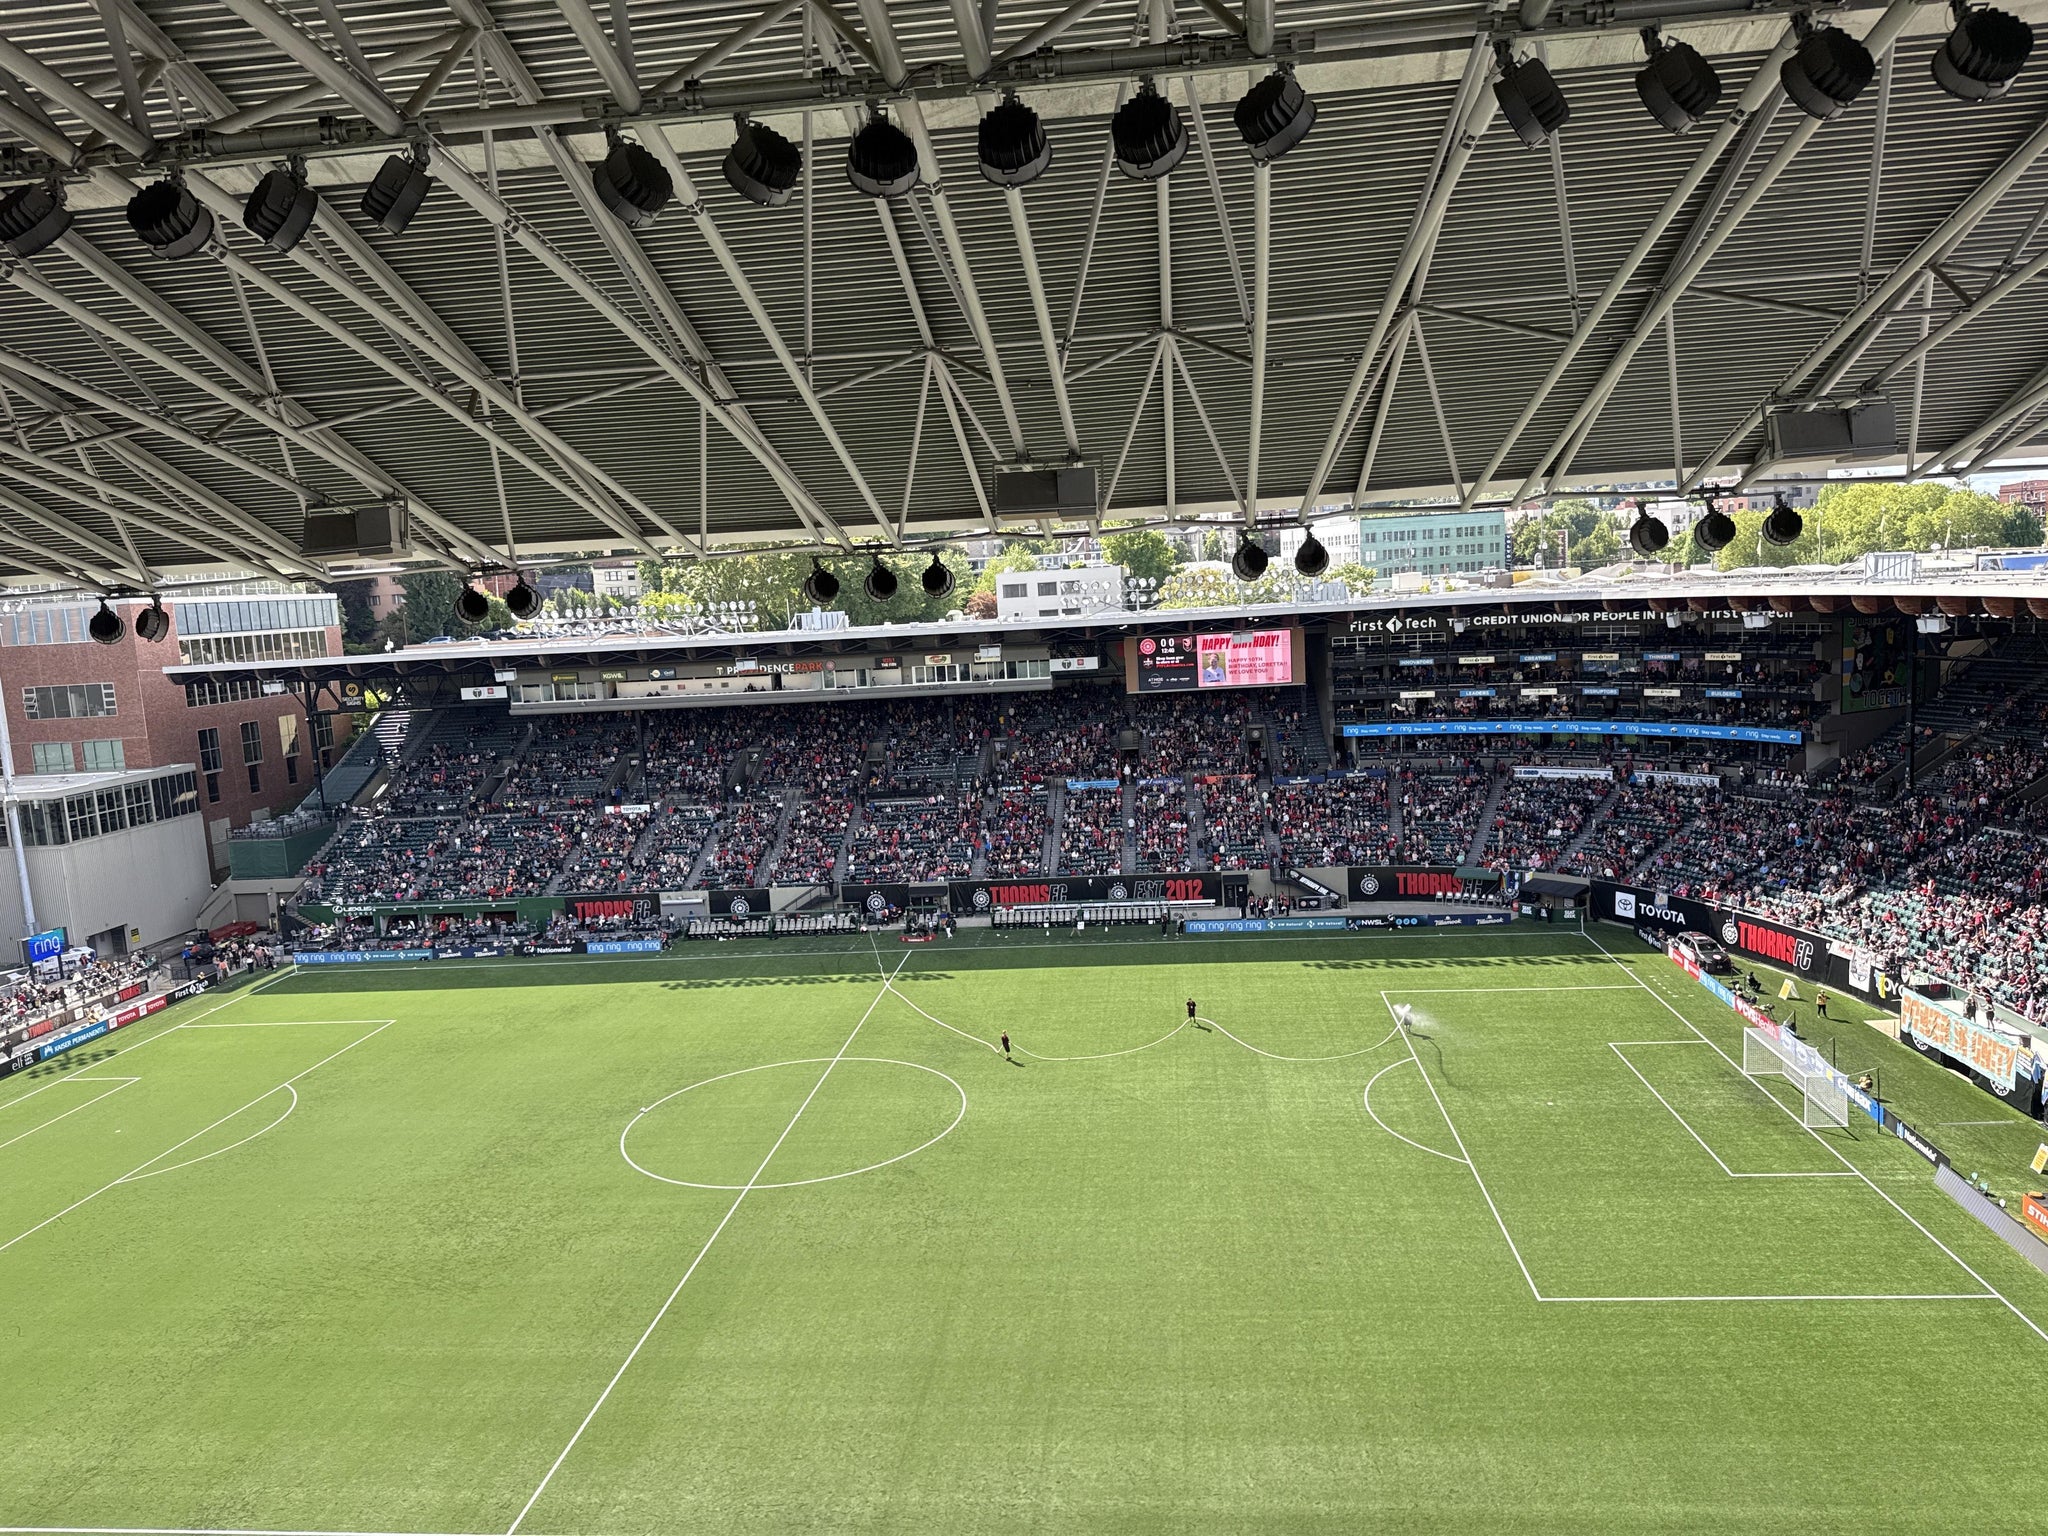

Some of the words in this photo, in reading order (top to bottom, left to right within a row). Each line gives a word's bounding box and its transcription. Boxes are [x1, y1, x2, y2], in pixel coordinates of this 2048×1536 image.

[1350, 620, 1383, 632] First
[1405, 617, 1437, 629] Tech
[1474, 615, 1518, 626] CREDIT
[1521, 613, 1562, 624] UNION
[1593, 611, 1639, 621] PEOPLE
[1643, 610, 1656, 620] IN
[1161, 639, 1165, 647] 0
[1169, 638, 1174, 647] 0
[1201, 637, 1231, 651] HAPPY
[1626, 725, 1639, 733] ring
[1686, 727, 1699, 735] ring
[1746, 731, 1758, 739] ring
[1134, 880, 1166, 899] EST
[1165, 879, 1203, 900] 2012
[1396, 872, 1462, 895] THORNS
[989, 884, 1049, 903] THORNS
[1049, 883, 1068, 902] FC
[575, 901, 633, 921] THORNS
[632, 900, 651, 919] FC
[1639, 903, 1686, 925] TOYOTA
[1190, 922, 1205, 932] ring
[1208, 921, 1224, 932] ring
[1226, 921, 1242, 931] ring
[1245, 920, 1261, 931] ring
[34, 935, 61, 956] ring
[537, 946, 572, 954] Nationwide
[588, 944, 604, 952] ring
[606, 943, 621, 952] ring
[627, 942, 642, 950] ring
[645, 941, 660, 950] ring
[1738, 921, 1796, 965] THORNS
[1793, 938, 1814, 970] FC
[311, 953, 324, 962] ring
[331, 953, 344, 962] ring
[347, 952, 361, 961] ring
[175, 989, 189, 999] First
[195, 980, 209, 991] Tech
[147, 1000, 165, 1011] TOYOTA
[118, 1012, 136, 1022] TOYOTA
[54, 1039, 72, 1053] KAISER
[71, 1025, 103, 1047] PERMANENTE
[1904, 1128, 1937, 1162] Nationwide
